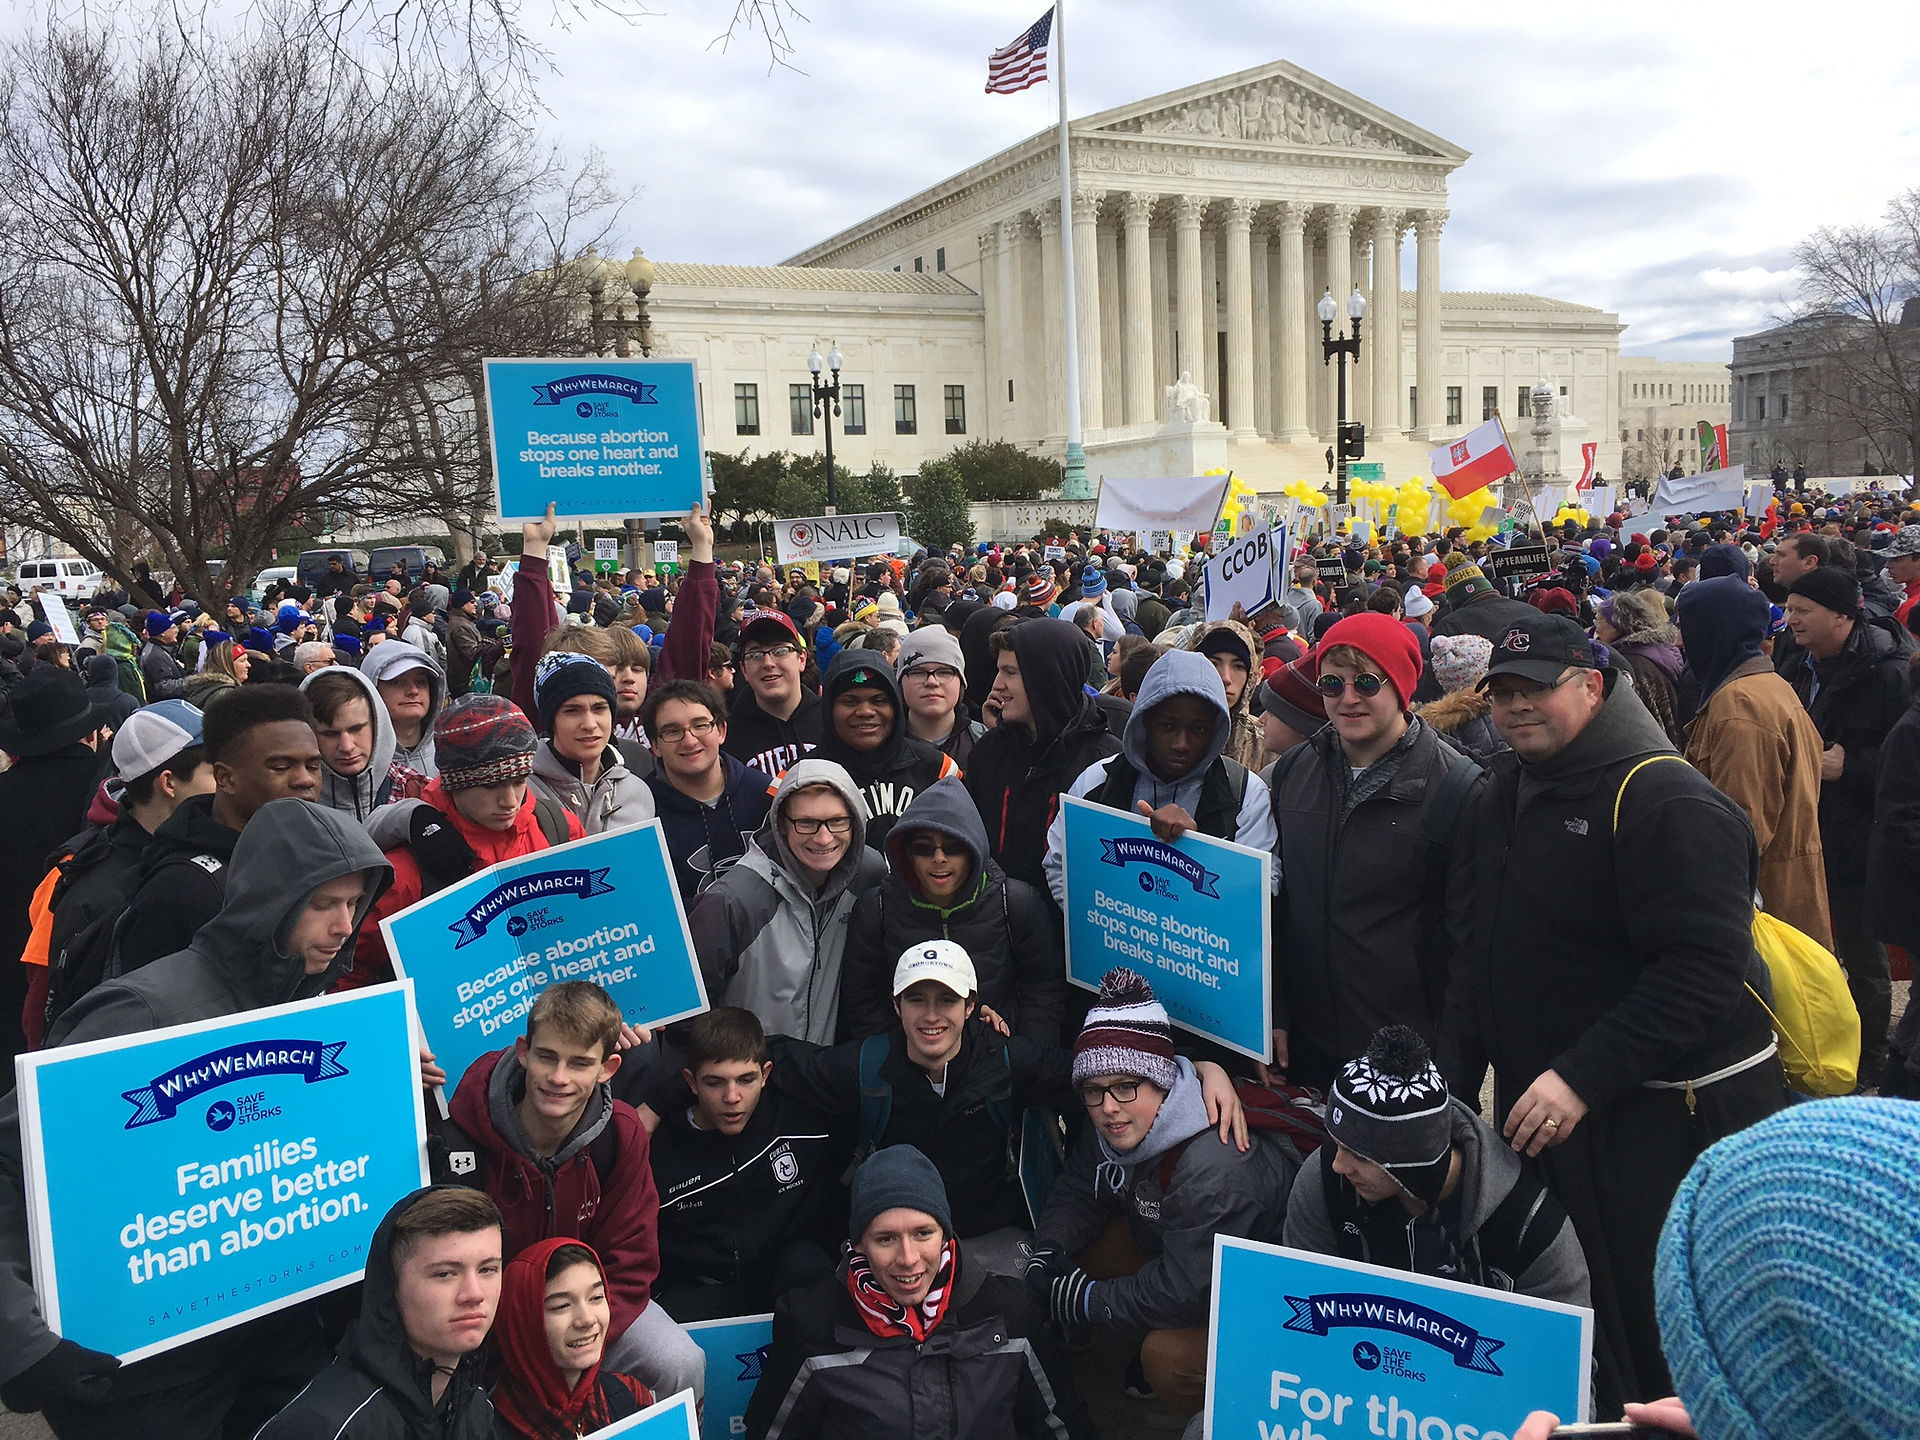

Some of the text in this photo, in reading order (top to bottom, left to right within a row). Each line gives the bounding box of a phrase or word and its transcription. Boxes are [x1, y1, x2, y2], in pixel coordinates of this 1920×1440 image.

[527, 429, 669, 446] Because abortion
[519, 445, 679, 464] stops one heart and
[539, 461, 663, 478] breaks another.
[814, 518, 885, 543] NALC
[596, 540, 616, 549] CHOOSE
[656, 543, 676, 552] CHOOSE
[1154, 539, 1164, 547] LIFE
[601, 549, 611, 558] LIFE
[661, 552, 671, 560] LIFE
[799, 548, 813, 557] Life!
[1222, 532, 1268, 582] CCOB
[1495, 553, 1547, 569] #TEAMLIFE
[1155, 875, 1171, 887] SAVE
[1155, 882, 1167, 891] THE
[1155, 887, 1179, 902] STORKS
[526, 907, 549, 919] SAVE
[528, 916, 546, 926] THE
[530, 916, 564, 932] STORKS
[1095, 890, 1230, 953] Because abortion
[1087, 908, 1239, 977] stops one heart and
[456, 921, 639, 1002] Because abortion
[923, 949, 938, 960] G
[1103, 931, 1221, 991] breaks another.
[453, 935, 656, 1029] stops one heart and
[237, 1091, 266, 1107] SAVE
[238, 1102, 260, 1115] THE
[238, 1106, 282, 1125] STORKS
[769, 1142, 791, 1160] CURLEY
[176, 1136, 318, 1195] Families
[119, 1154, 370, 1249] deserve better
[128, 1191, 369, 1285] than abortion.
[1383, 1347, 1412, 1362] SAVE
[1383, 1356, 1405, 1369] THE
[1382, 1364, 1427, 1383] STORKS
[1270, 1370, 1354, 1426] For
